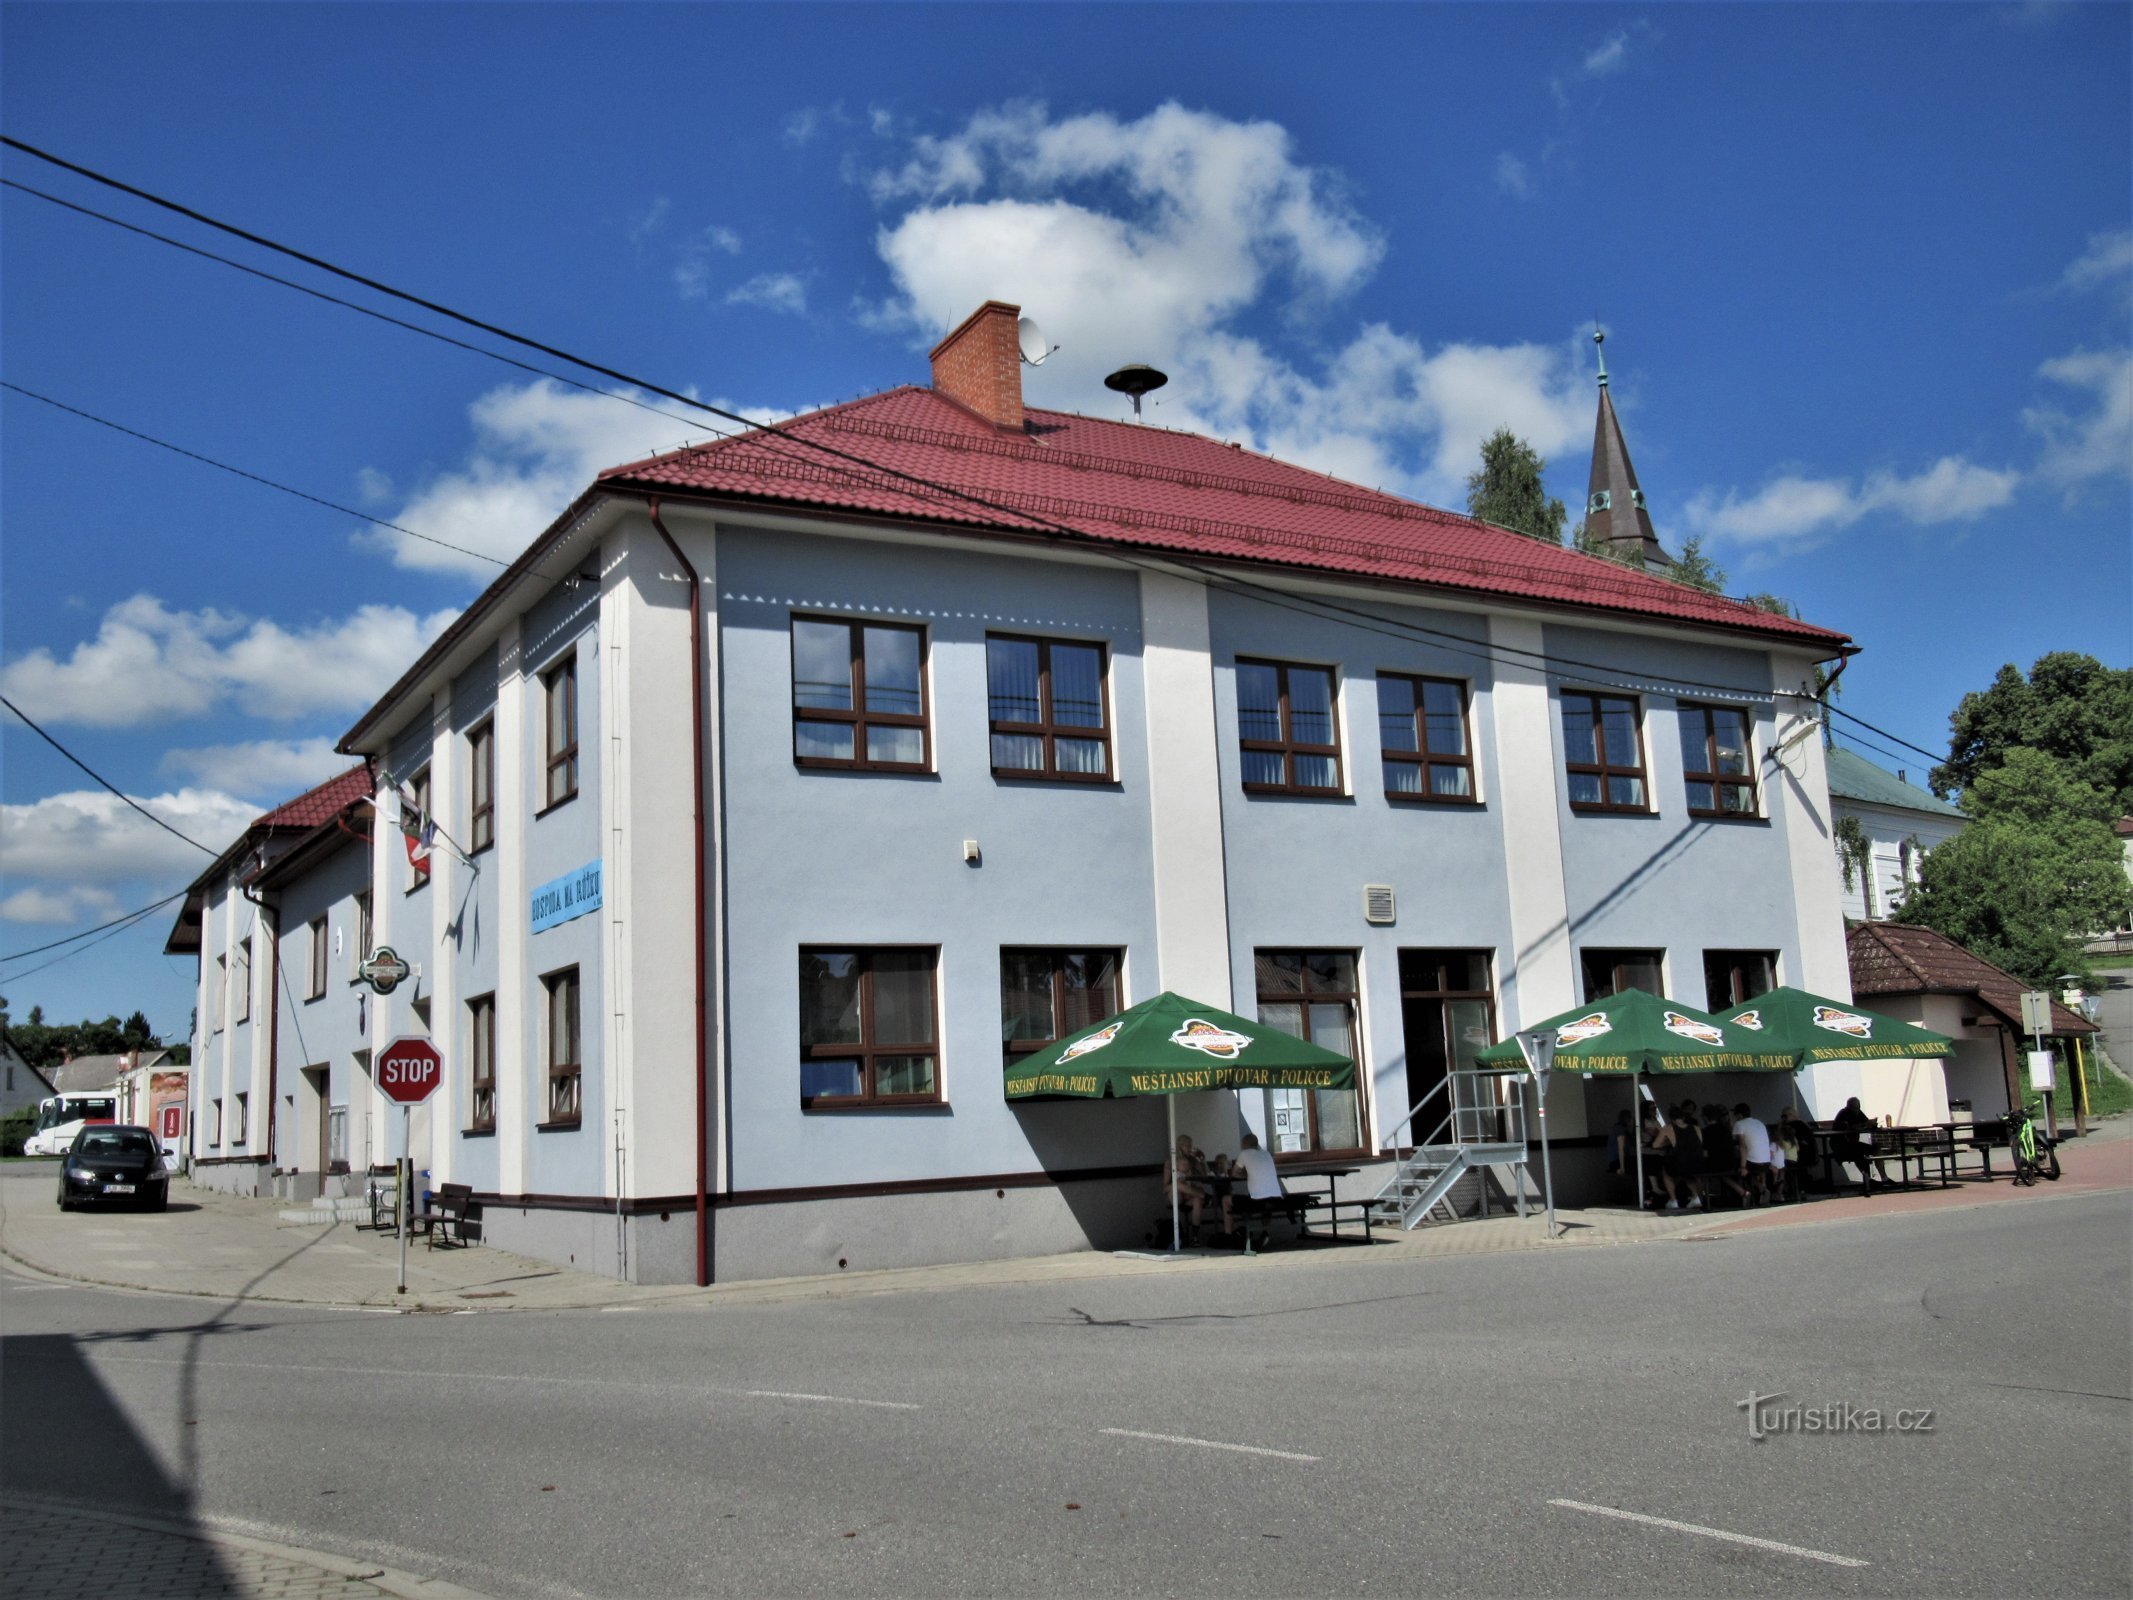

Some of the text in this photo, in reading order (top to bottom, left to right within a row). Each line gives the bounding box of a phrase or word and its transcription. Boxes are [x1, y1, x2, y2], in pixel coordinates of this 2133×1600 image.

[1864, 1044, 1904, 1057] PIVOVAR
[1717, 1053, 1754, 1068] PIVOVAR
[386, 1058, 435, 1083] STOP
[1281, 1066, 1332, 1086] POLIČCE
